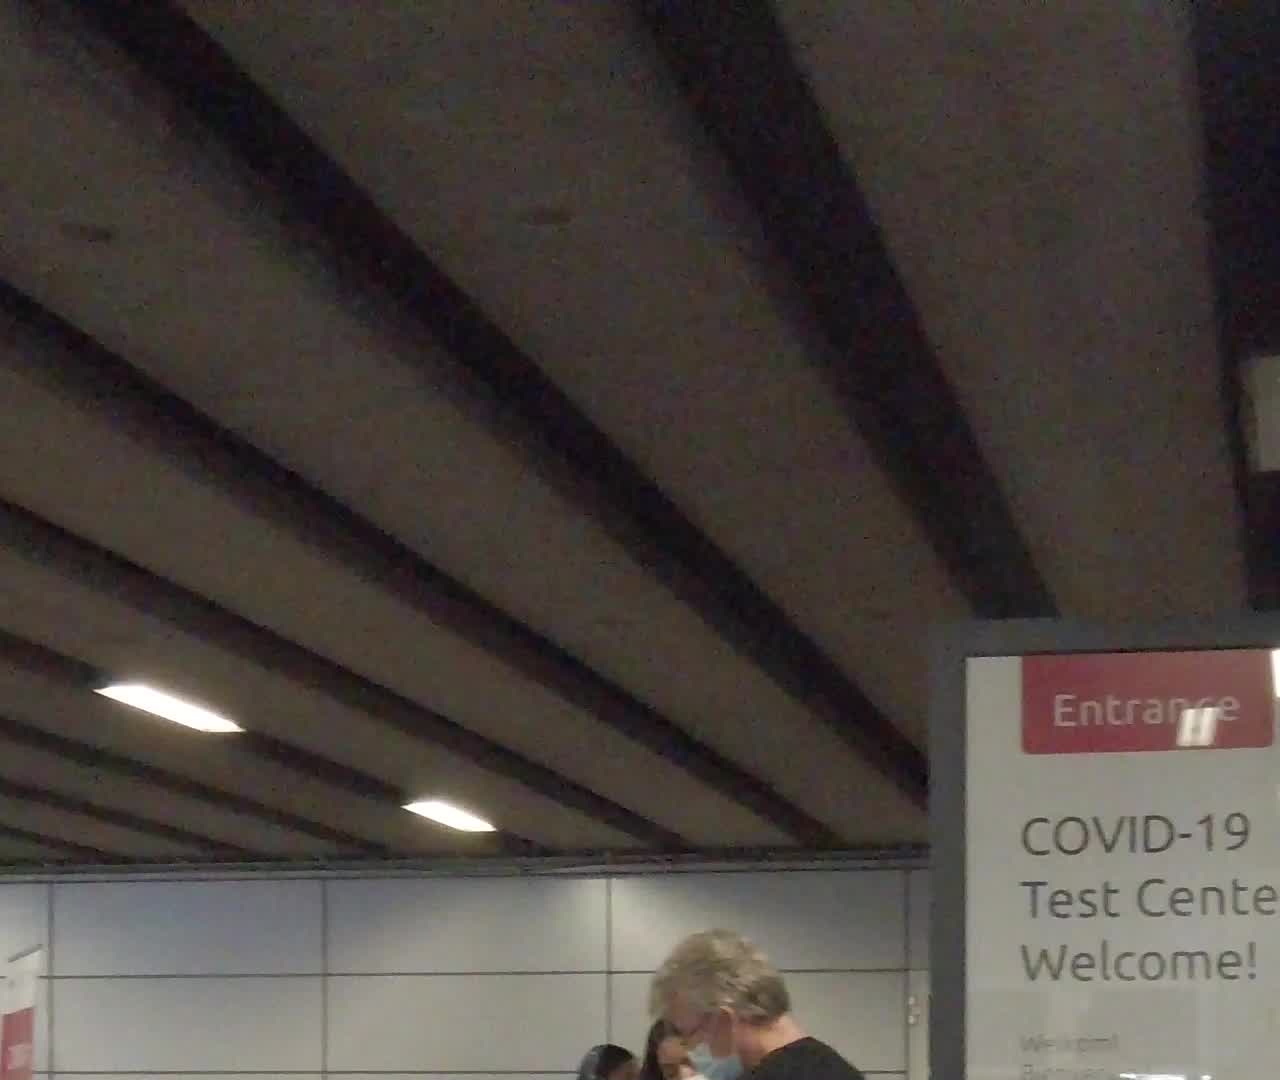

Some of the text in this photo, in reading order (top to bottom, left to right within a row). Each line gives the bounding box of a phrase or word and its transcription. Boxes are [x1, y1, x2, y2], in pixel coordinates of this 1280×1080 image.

[1022, 812, 1252, 856] COVID-19
[1020, 880, 1121, 919] Test
[1020, 940, 1258, 982] Welcome!
